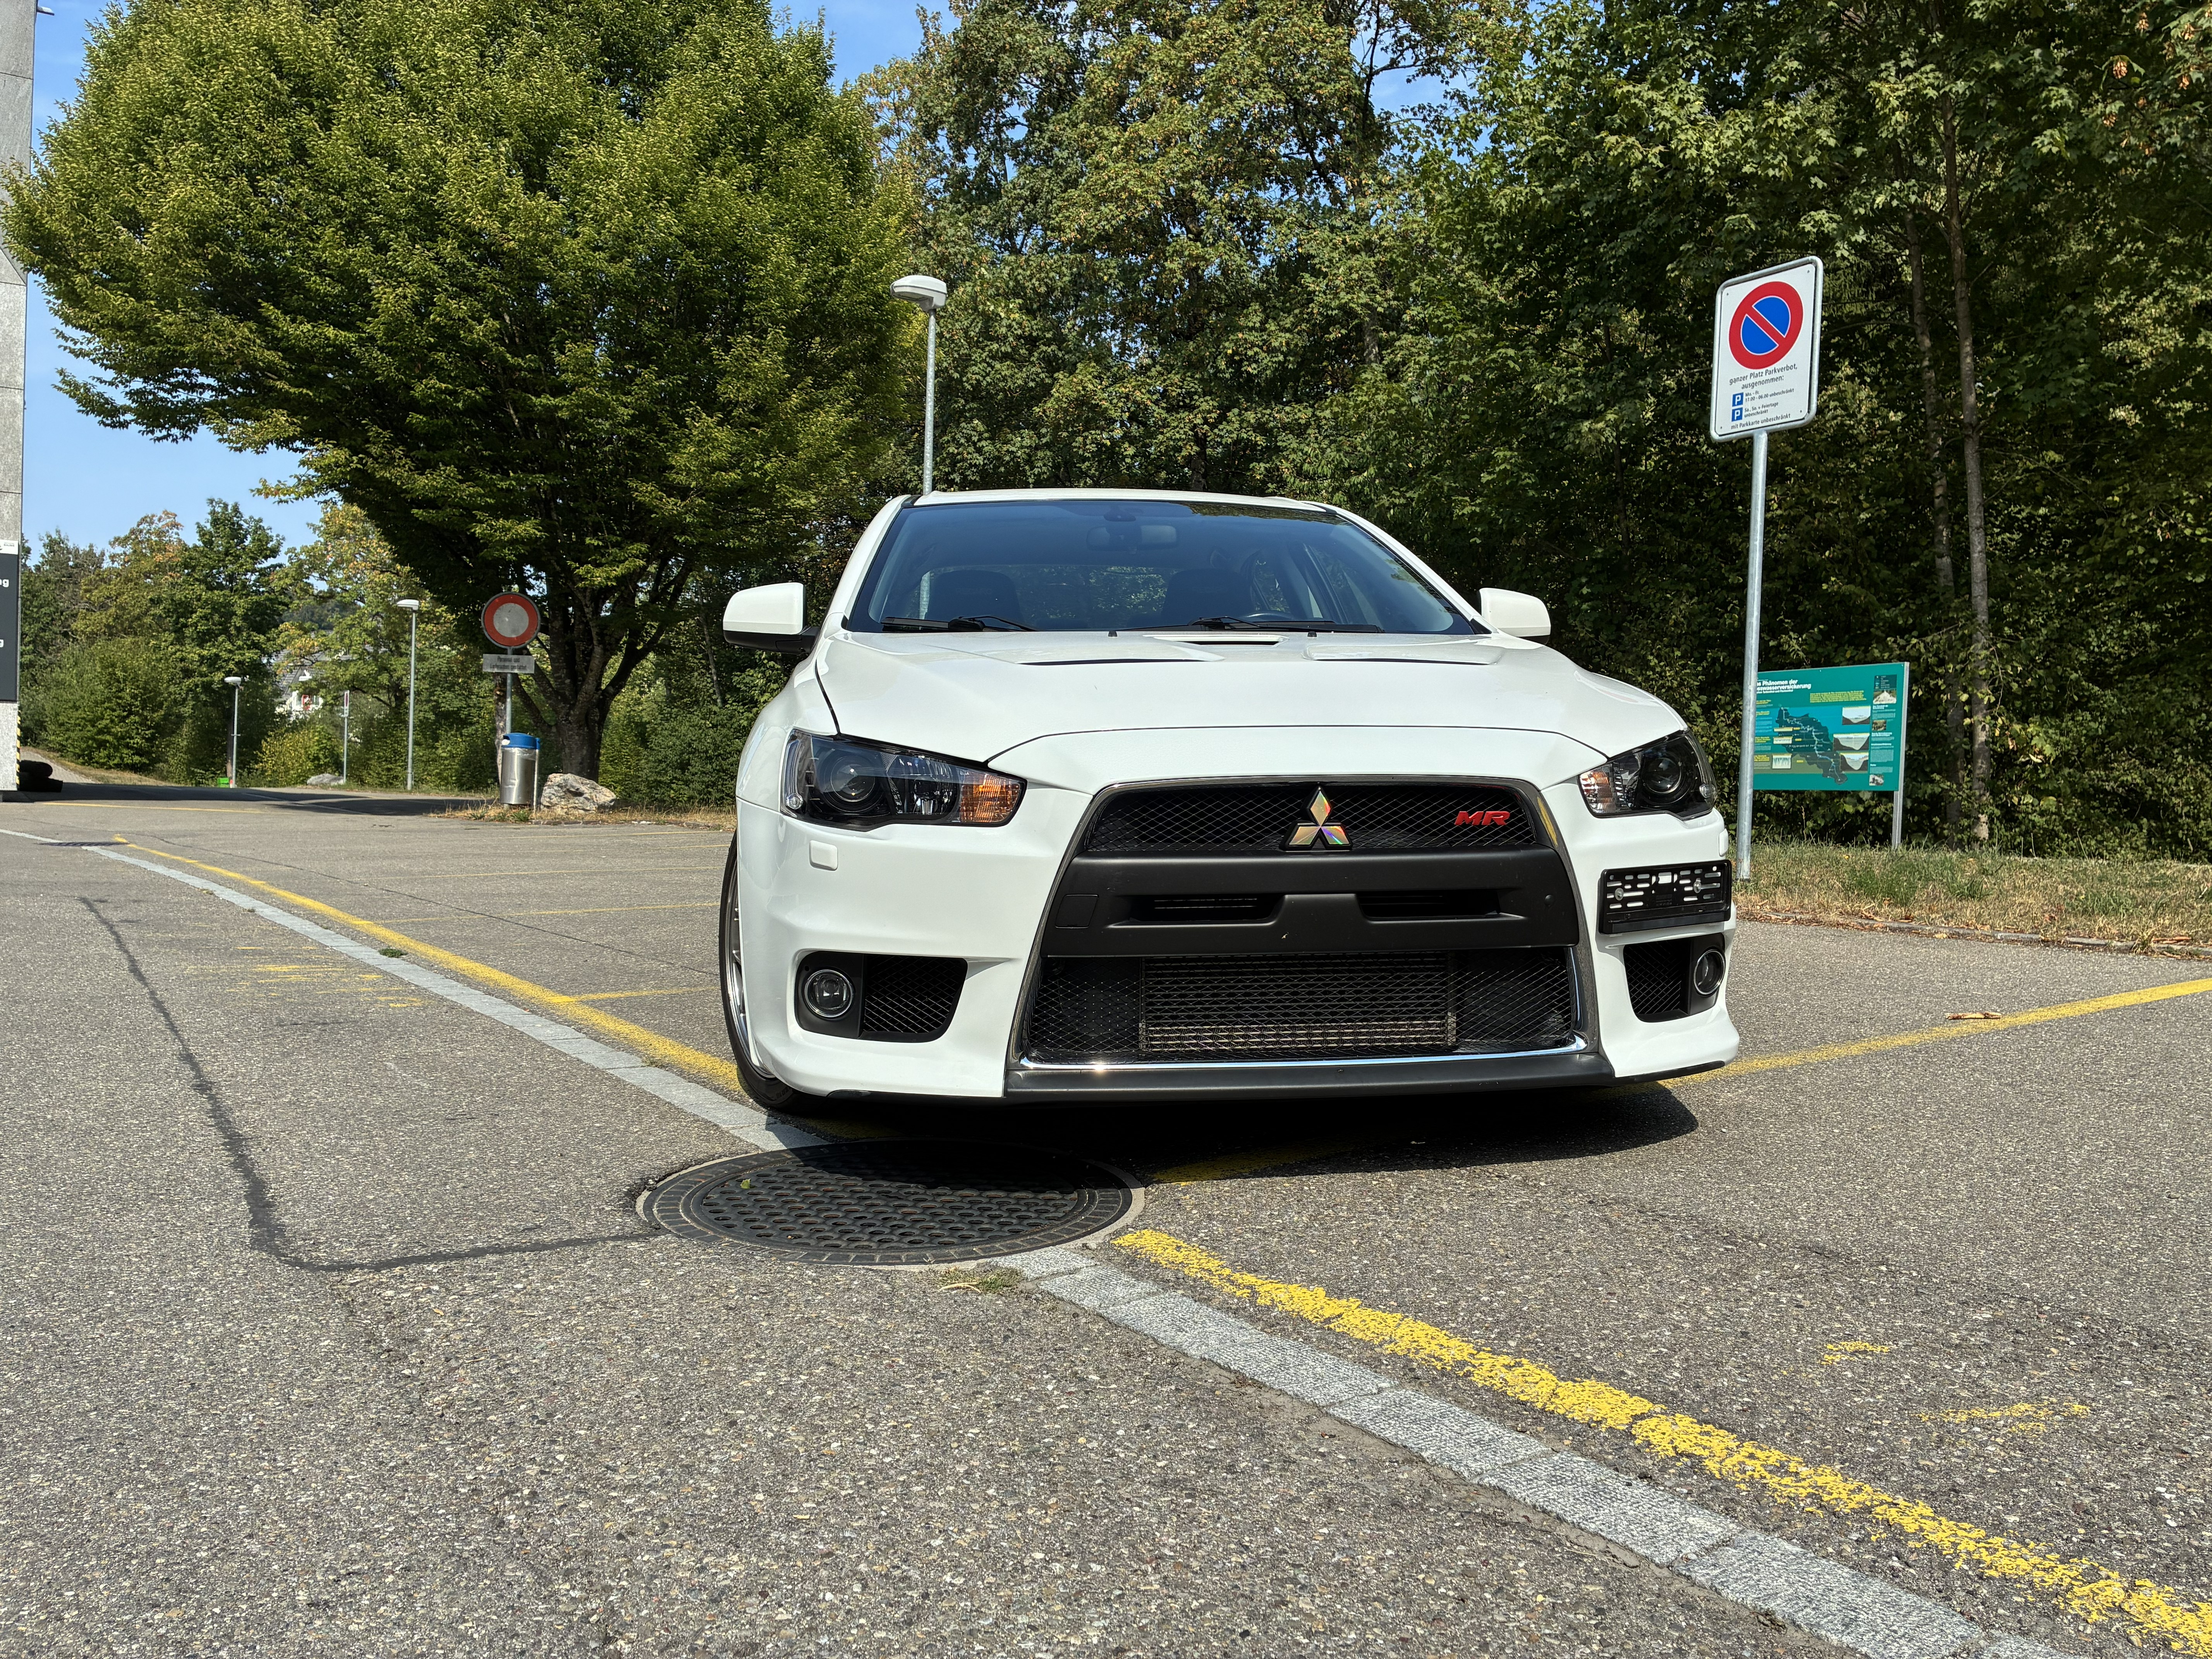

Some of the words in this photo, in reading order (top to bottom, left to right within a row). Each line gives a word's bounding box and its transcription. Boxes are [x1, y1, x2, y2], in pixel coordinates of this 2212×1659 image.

[1729, 375, 1748, 385] ganzer
[1765, 363, 1797, 376] Parkverbot,
[1741, 375, 1784, 389] ausgenommen:
[1769, 388, 1794, 397] unbeschränkt
[1740, 420, 1760, 428] Parkkarte
[1761, 413, 1791, 423] unbeschränkt
[1744, 409, 1768, 418] unbeschränkt
[1454, 811, 1510, 825] MR
